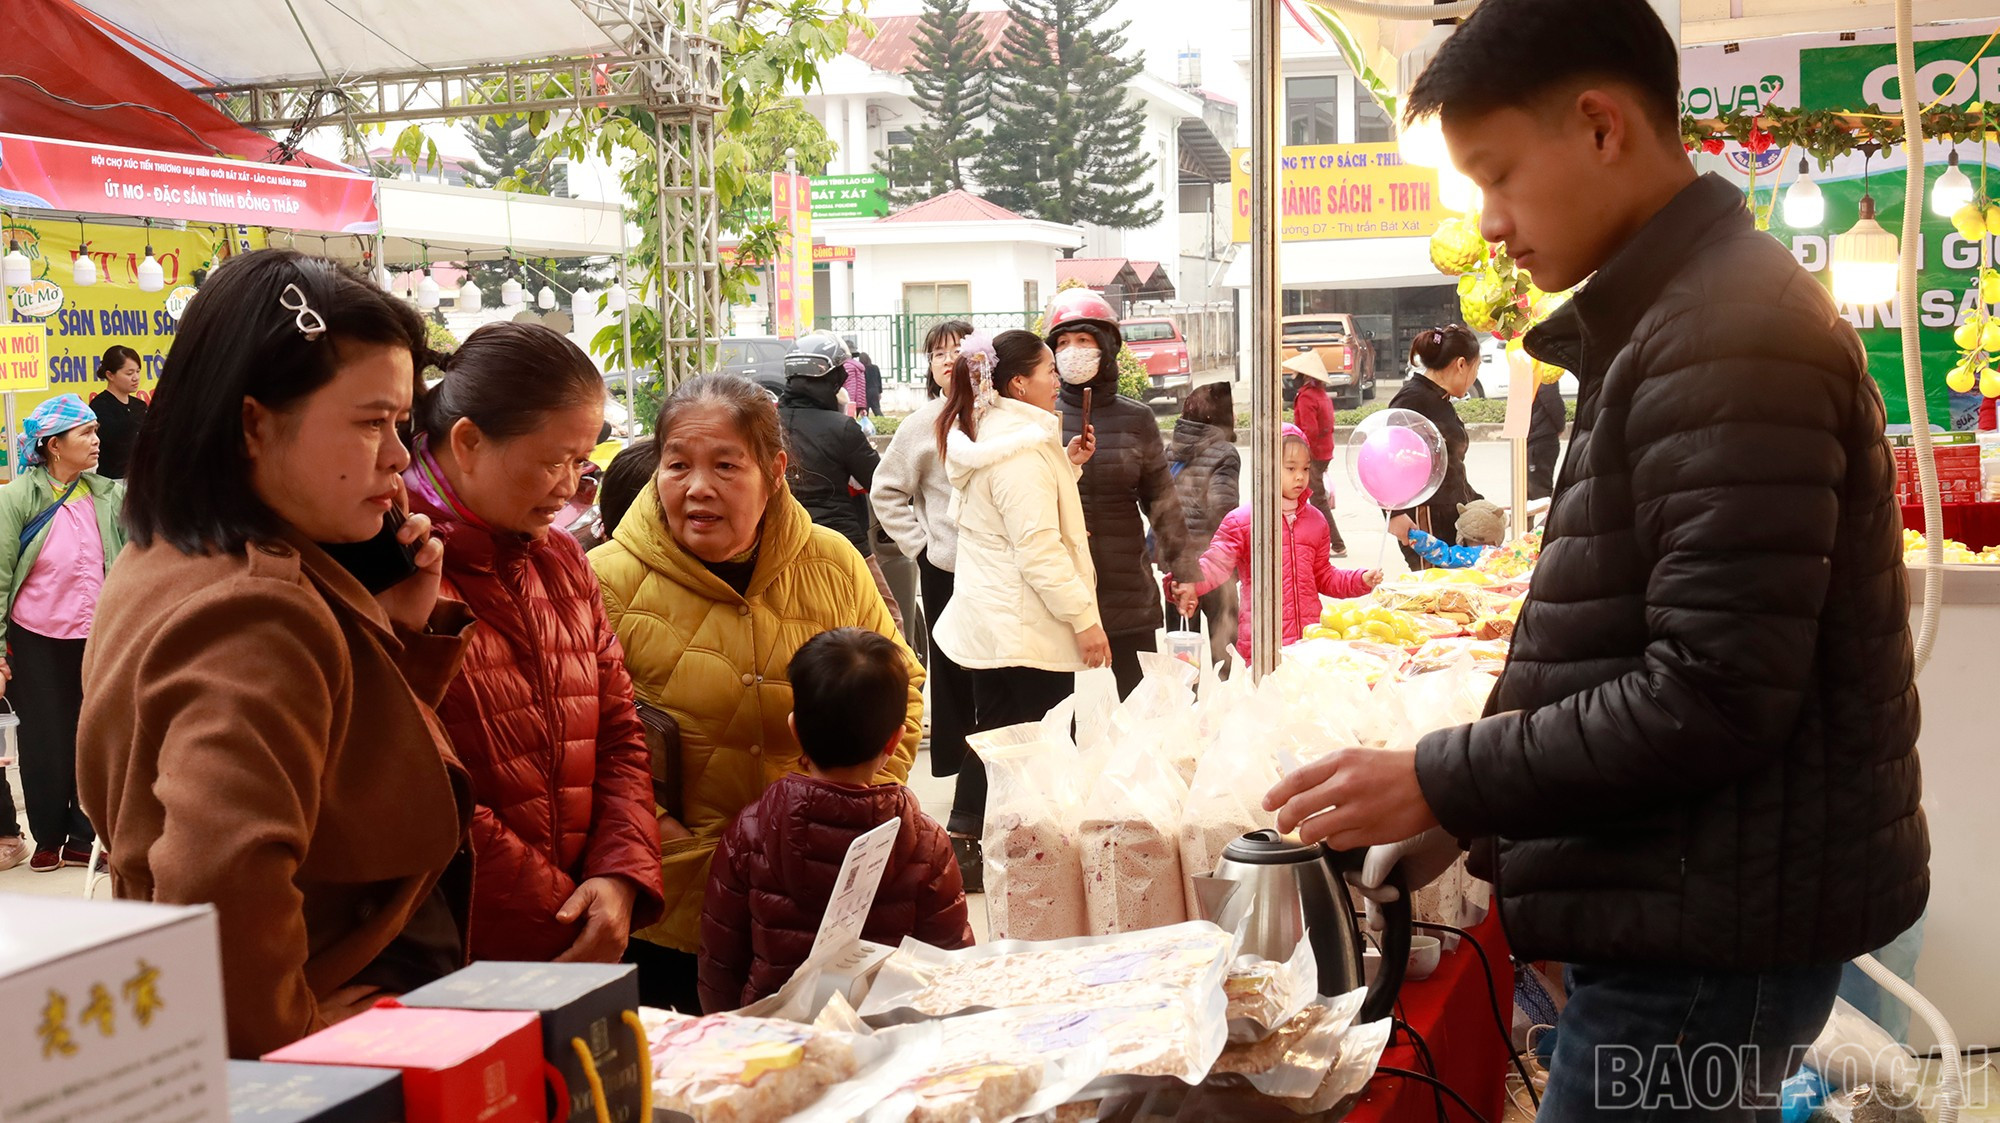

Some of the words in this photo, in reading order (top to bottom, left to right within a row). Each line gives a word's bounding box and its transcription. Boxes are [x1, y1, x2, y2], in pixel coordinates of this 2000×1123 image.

[90, 154, 105, 167] HỘI
[105, 157, 122, 169] CHỢ
[123, 158, 139, 169] XÚC
[139, 159, 153, 171] TIẾN
[154, 162, 181, 174] THƯƠNG
[182, 166, 195, 177] MẠI
[210, 168, 225, 179] GIỚI
[253, 173, 266, 183] LÀO
[266, 176, 277, 185] CAI
[292, 179, 307, 188] 2026
[1301, 156, 1316, 169] TY
[1319, 155, 1334, 169] CP
[1337, 151, 1367, 168] SÁCH
[861, 177, 875, 185] CAI
[105, 178, 120, 198] ÚT
[122, 184, 144, 200] MƠ
[153, 185, 180, 206] ĐẶC
[183, 185, 208, 206] SẢN
[208, 188, 235, 208] TỈNH
[236, 189, 271, 212] ĐỒNG
[271, 196, 300, 214] THÁP
[811, 189, 836, 200] BÁT
[840, 187, 867, 199] XÁT
[1327, 178, 1372, 214] SÁCH
[1388, 182, 1431, 212] TBTH
[1313, 223, 1328, 234] D7
[1337, 223, 1353, 233] Thị
[1402, 220, 1419, 231] Xát
[18, 290, 33, 308] Út
[38, 288, 59, 303] Mơ
[58, 300, 95, 336] SẢN
[100, 304, 148, 336] BÁNH
[11, 332, 39, 354] MỜI
[11, 355, 39, 379] THỬ
[50, 347, 87, 383] SẢN
